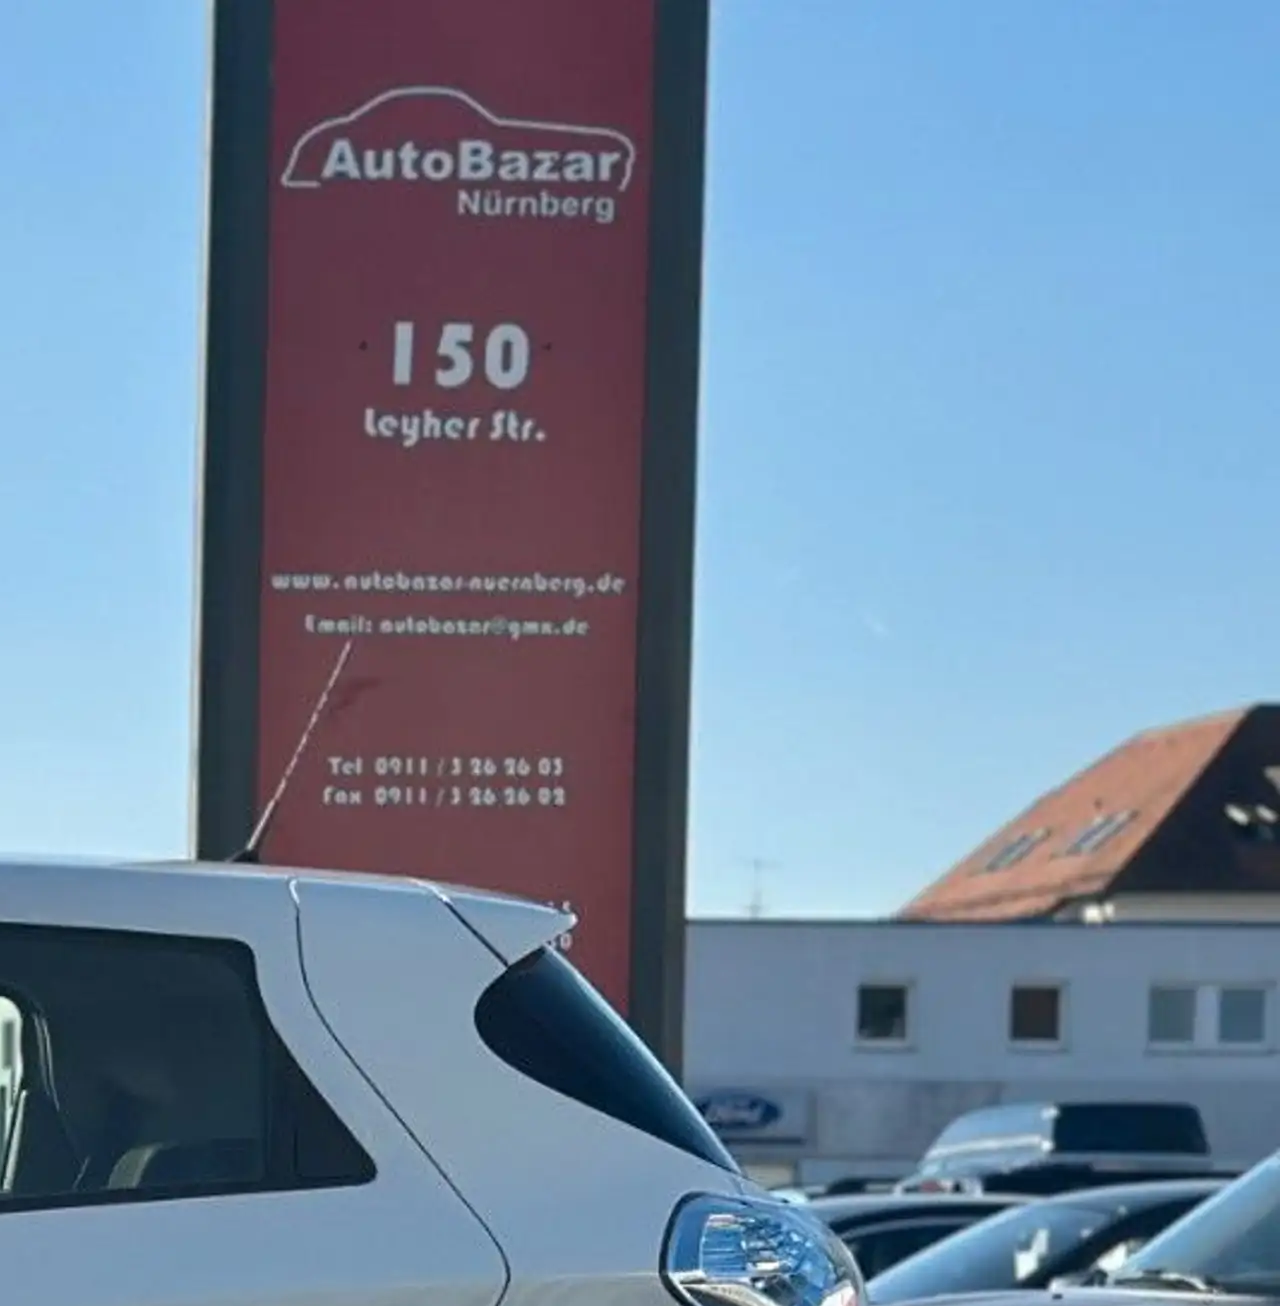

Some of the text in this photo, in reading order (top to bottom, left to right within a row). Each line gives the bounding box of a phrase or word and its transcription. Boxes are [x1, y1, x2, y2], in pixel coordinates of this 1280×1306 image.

[321, 138, 622, 182] AutoBazar
[457, 190, 616, 223] Nürnberg
[392, 320, 530, 389] 150
[363, 407, 546, 447] Leyher Str.
[328, 756, 363, 776] Tel
[374, 756, 428, 776] 0911
[322, 786, 362, 806] Fax
